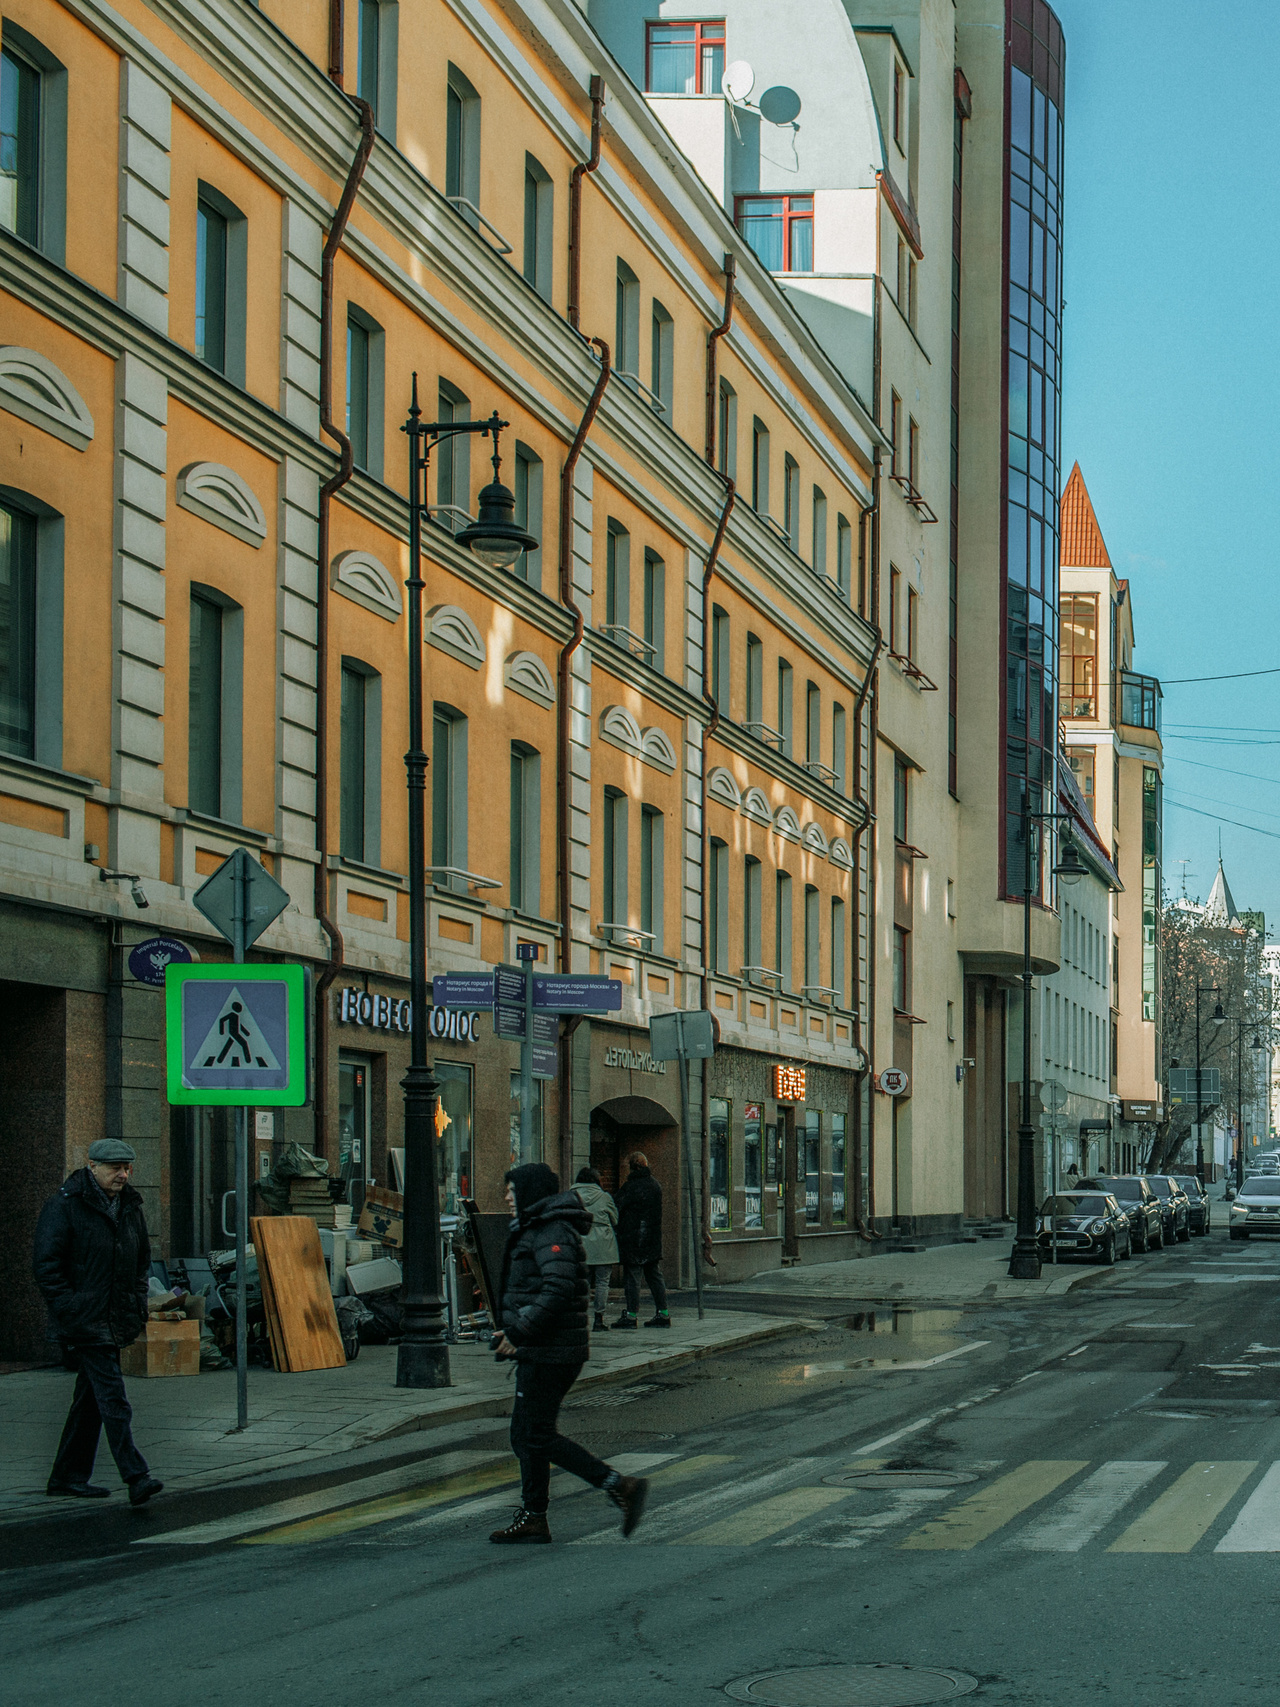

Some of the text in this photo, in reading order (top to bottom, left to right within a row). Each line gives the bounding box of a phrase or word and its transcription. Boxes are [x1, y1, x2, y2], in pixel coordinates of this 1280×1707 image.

[136, 940, 184, 954] Imperial Porcelain
[373, 994, 413, 1033] ВЕС
